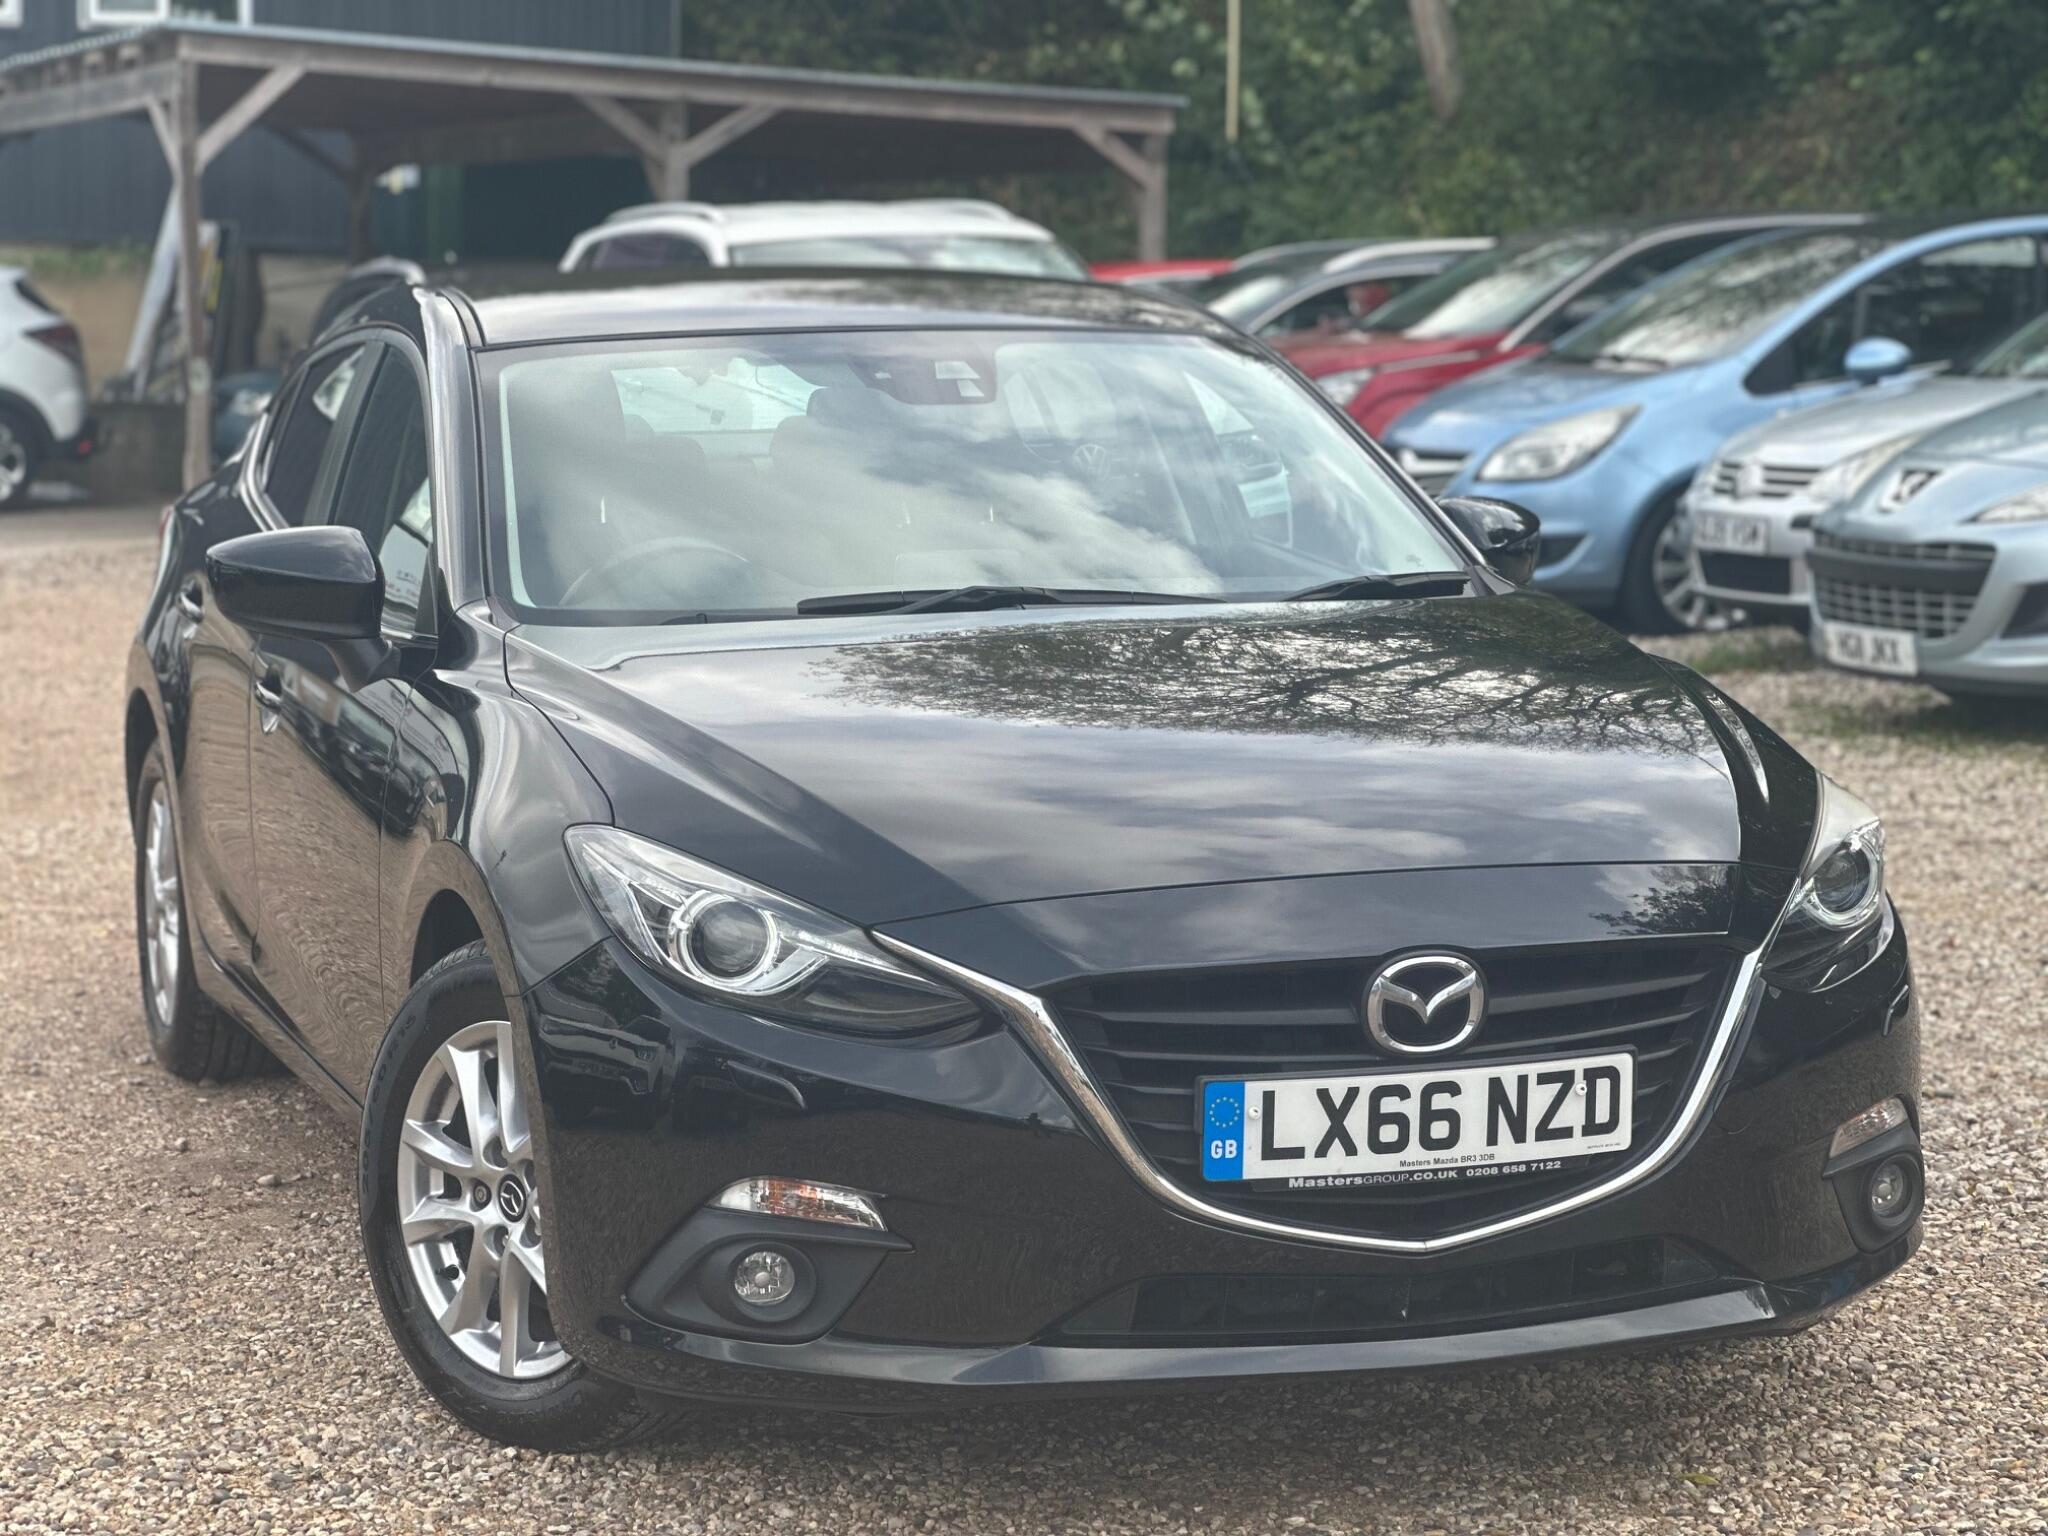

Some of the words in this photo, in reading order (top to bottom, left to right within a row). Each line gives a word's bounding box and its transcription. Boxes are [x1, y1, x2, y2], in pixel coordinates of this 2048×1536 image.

[1261, 1080, 1462, 1161] LX66
[1486, 1065, 1621, 1147] NZD
[1210, 1139, 1238, 1160] GB
[1399, 1159, 1431, 1168] Masters
[1433, 1157, 1459, 1166] Mazda
[1460, 1155, 1477, 1163] BR3
[1478, 1153, 1495, 1162] 3DB
[1466, 1166, 1498, 1177] 0208
[1502, 1163, 1526, 1174] 658
[1530, 1160, 1561, 1171] 7122
